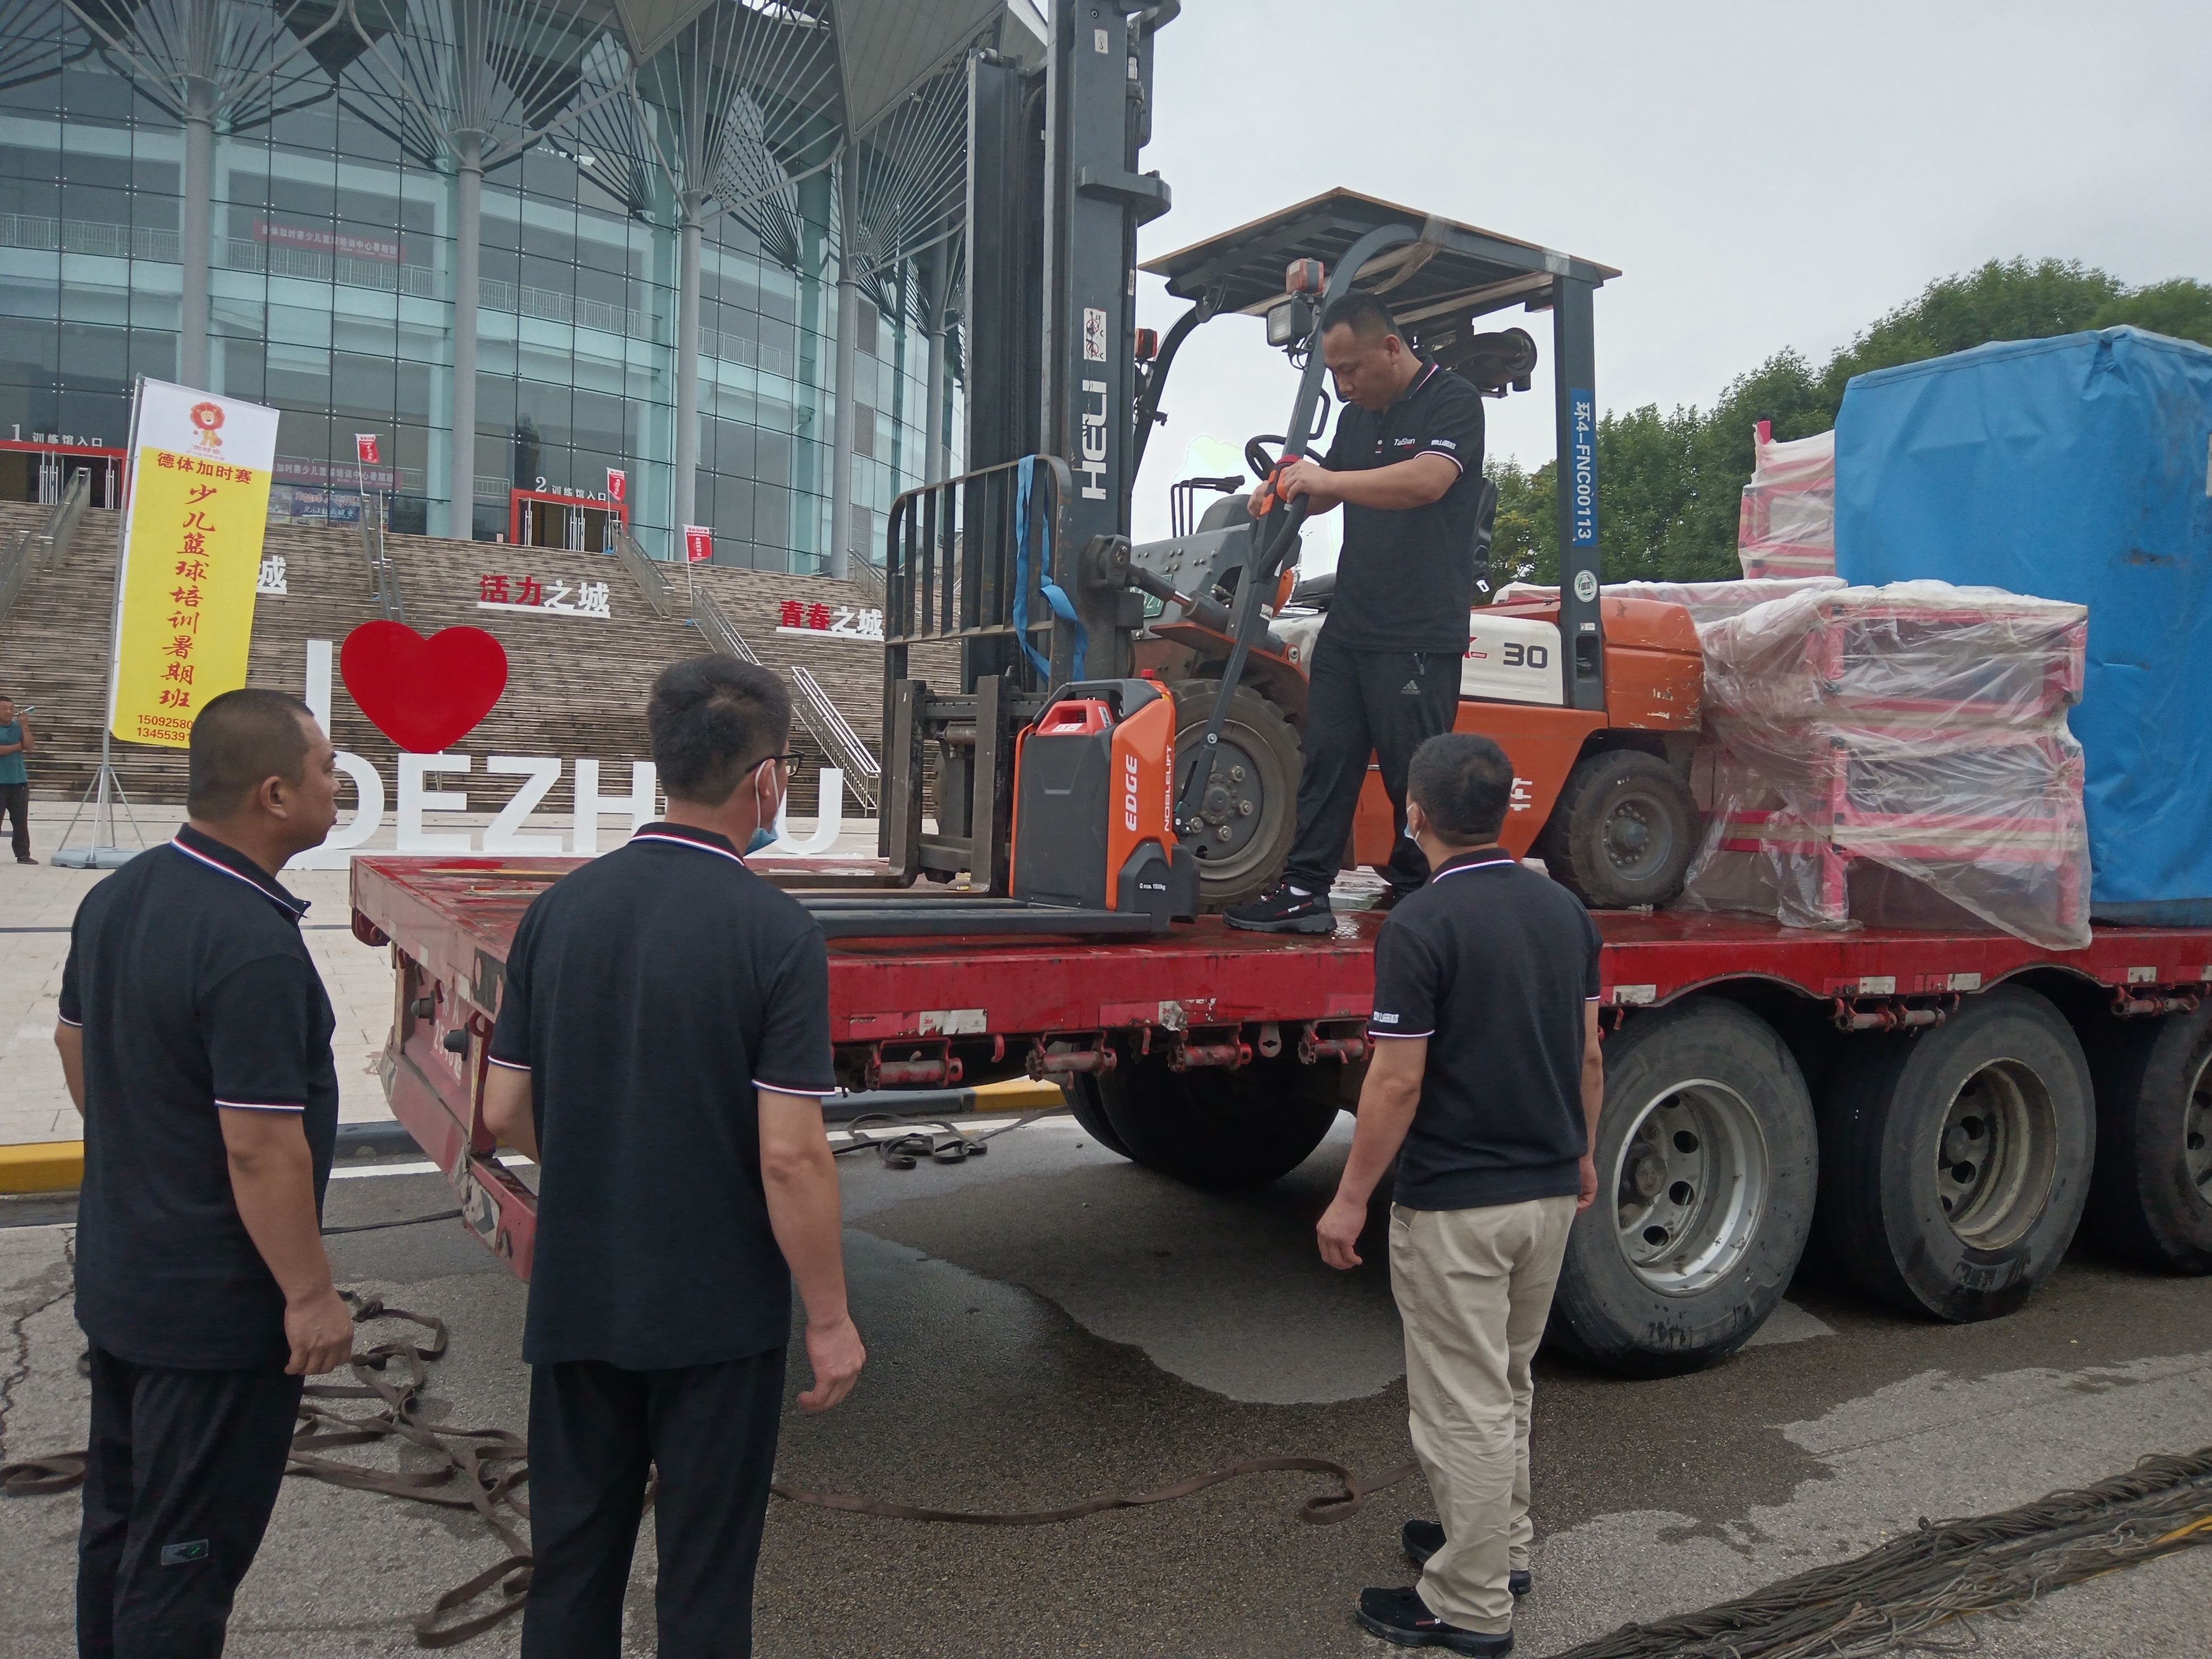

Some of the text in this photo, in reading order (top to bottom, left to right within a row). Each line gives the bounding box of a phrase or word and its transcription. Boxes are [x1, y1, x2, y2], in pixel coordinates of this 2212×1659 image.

[12, 424, 102, 447] 1 训练馆入口
[1082, 380, 1107, 500] HELI
[157, 452, 252, 484] 德体加时赛
[1574, 401, 1591, 539] 环4-FNC00113
[535, 476, 547, 493] 2
[551, 485, 606, 501] 训练馆入口
[257, 556, 287, 588] 城
[158, 483, 217, 709] 少儿篮球培训暑期班
[479, 574, 610, 612] 活力之城
[778, 600, 883, 635] 青春之城
[1503, 642, 1548, 669] 30
[321, 750, 843, 854] DEZHU
[1125, 755, 1137, 832] EDGE
